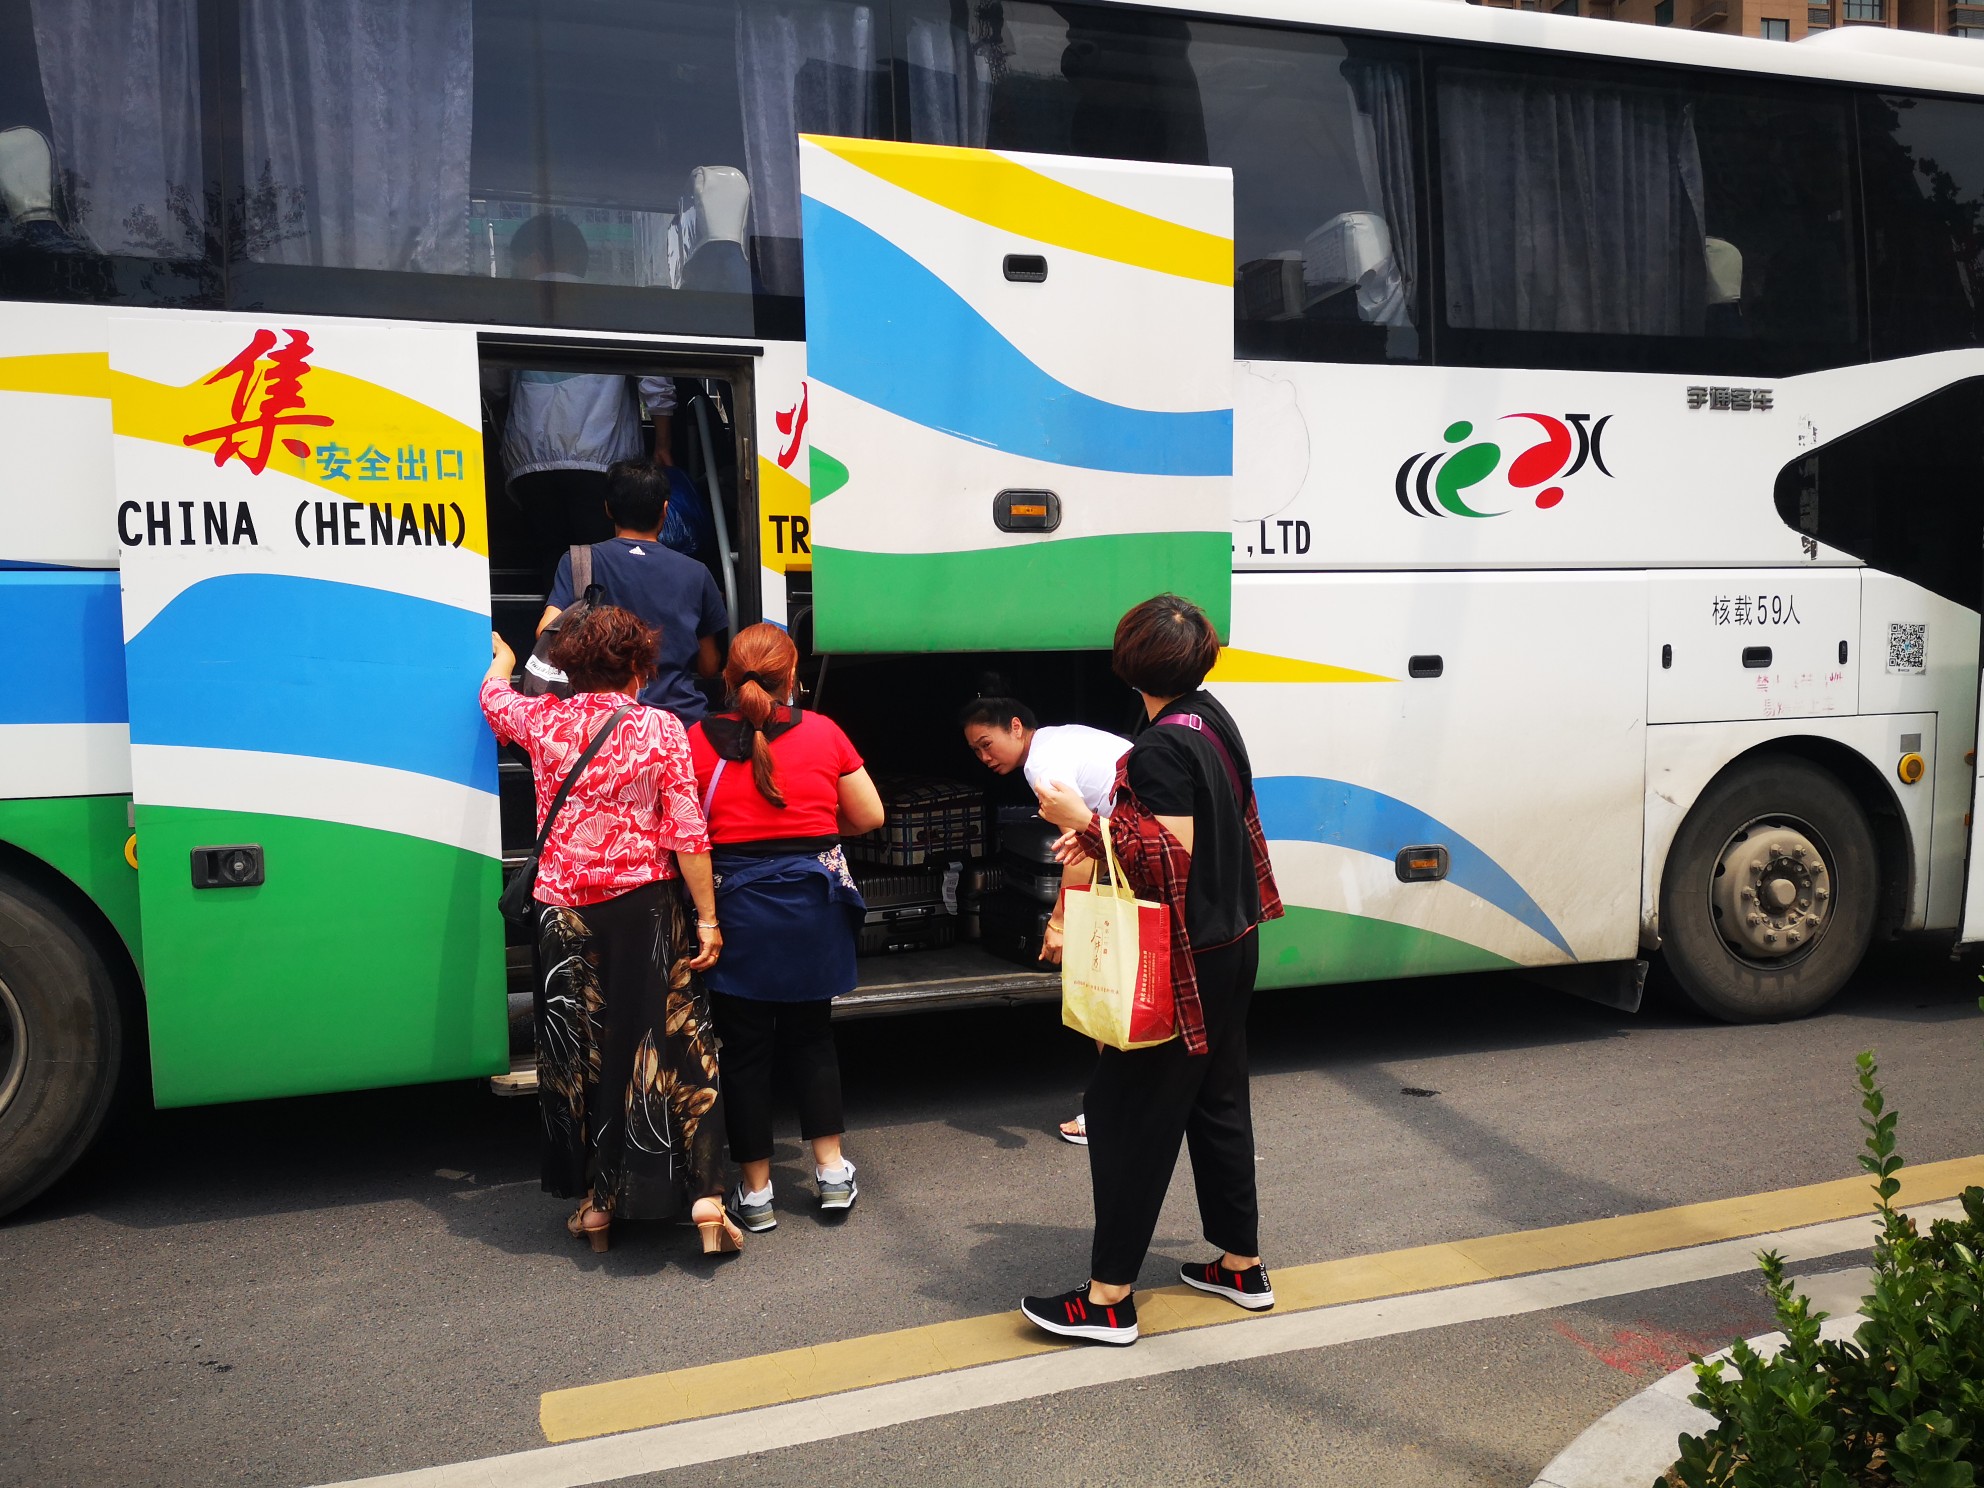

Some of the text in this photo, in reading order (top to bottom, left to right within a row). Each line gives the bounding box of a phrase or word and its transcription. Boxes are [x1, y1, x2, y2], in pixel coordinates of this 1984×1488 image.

[183, 328, 335, 477] 集
[1687, 386, 1774, 411] 宇通客车
[316, 442, 464, 481] 安全出口
[118, 499, 465, 548] CHINA (HENAN)
[1712, 594, 1801, 626] 核载59人
